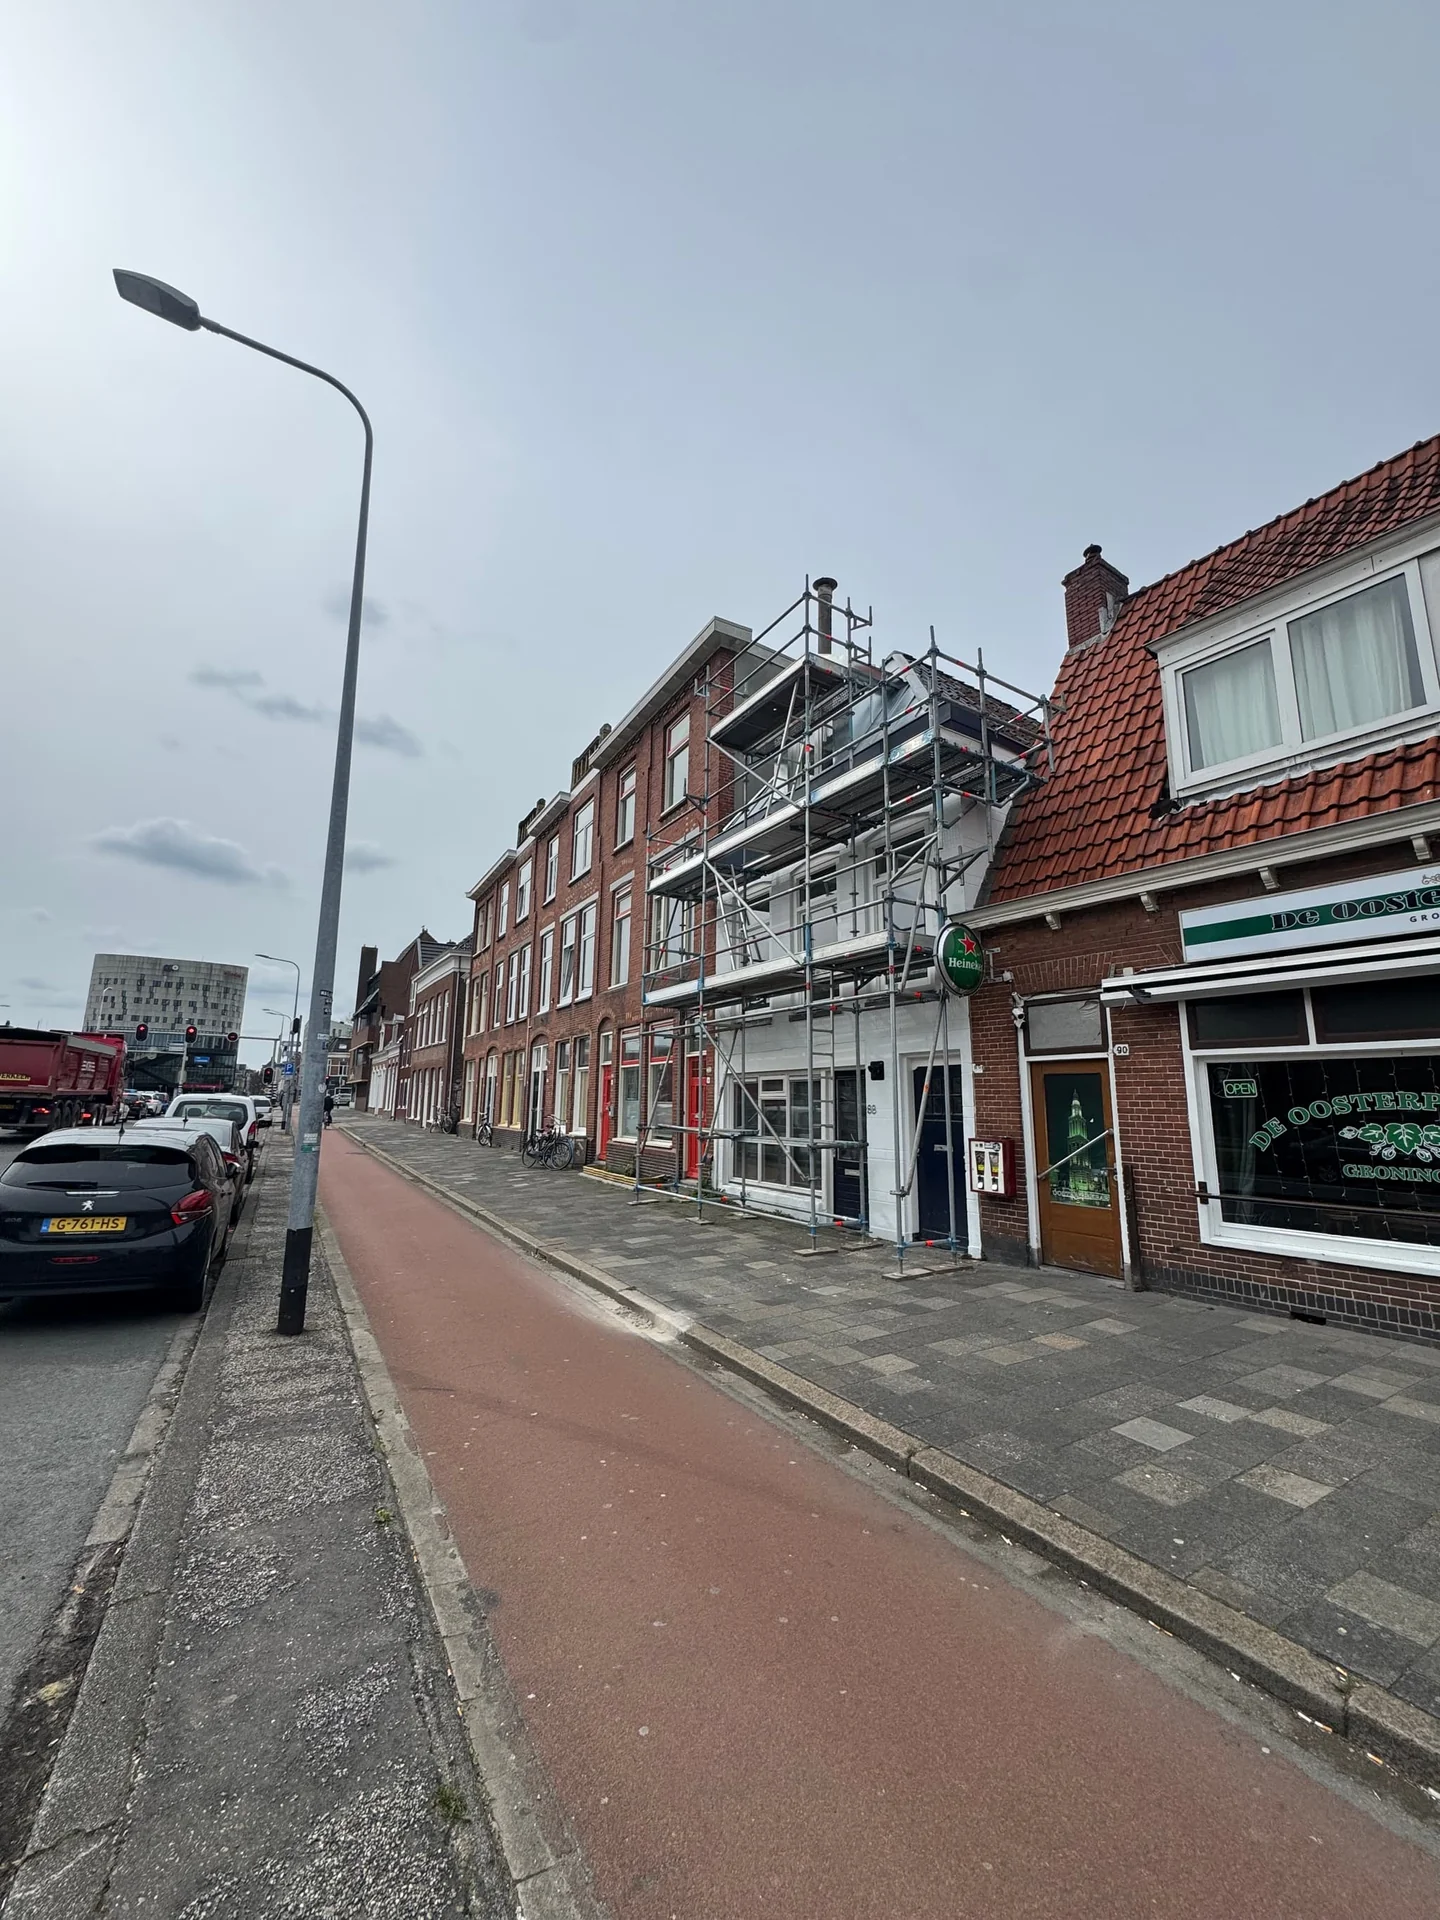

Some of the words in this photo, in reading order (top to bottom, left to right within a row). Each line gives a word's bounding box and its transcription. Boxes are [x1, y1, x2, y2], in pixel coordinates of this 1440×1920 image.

[1270, 910, 1320, 930] De
[1116, 1045, 1128, 1054] 90
[1225, 1083, 1256, 1095] OPEN
[866, 1104, 877, 1115] 88
[1248, 1116, 1288, 1151] DE
[1287, 1091, 1440, 1125] OOSTERP
[56, 1218, 120, 1230] G-761-HS
